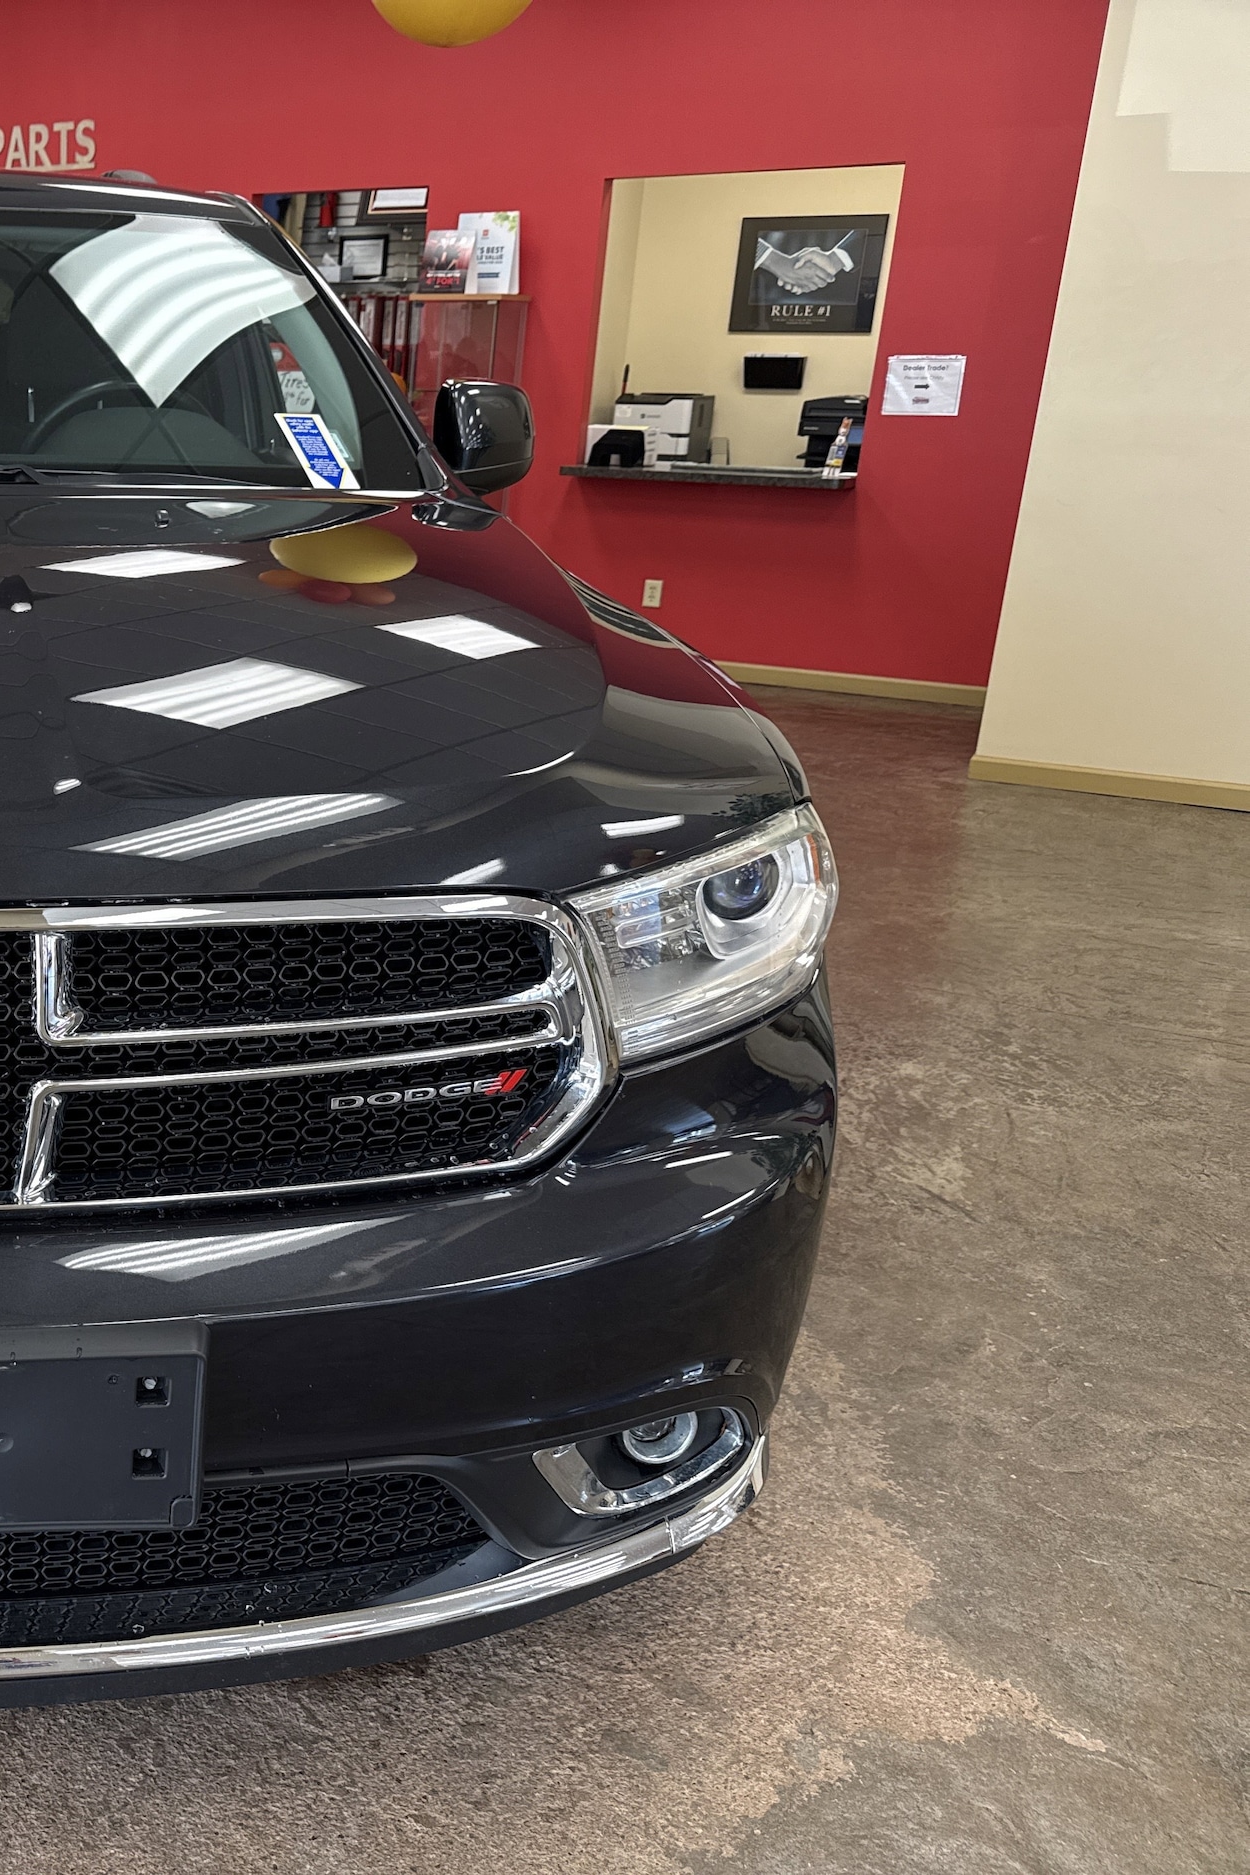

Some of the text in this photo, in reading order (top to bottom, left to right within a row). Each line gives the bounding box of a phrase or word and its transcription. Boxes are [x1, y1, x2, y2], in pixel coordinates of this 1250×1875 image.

[770, 305, 831, 317] RULE #1
[330, 1077, 503, 1110] DODGE
